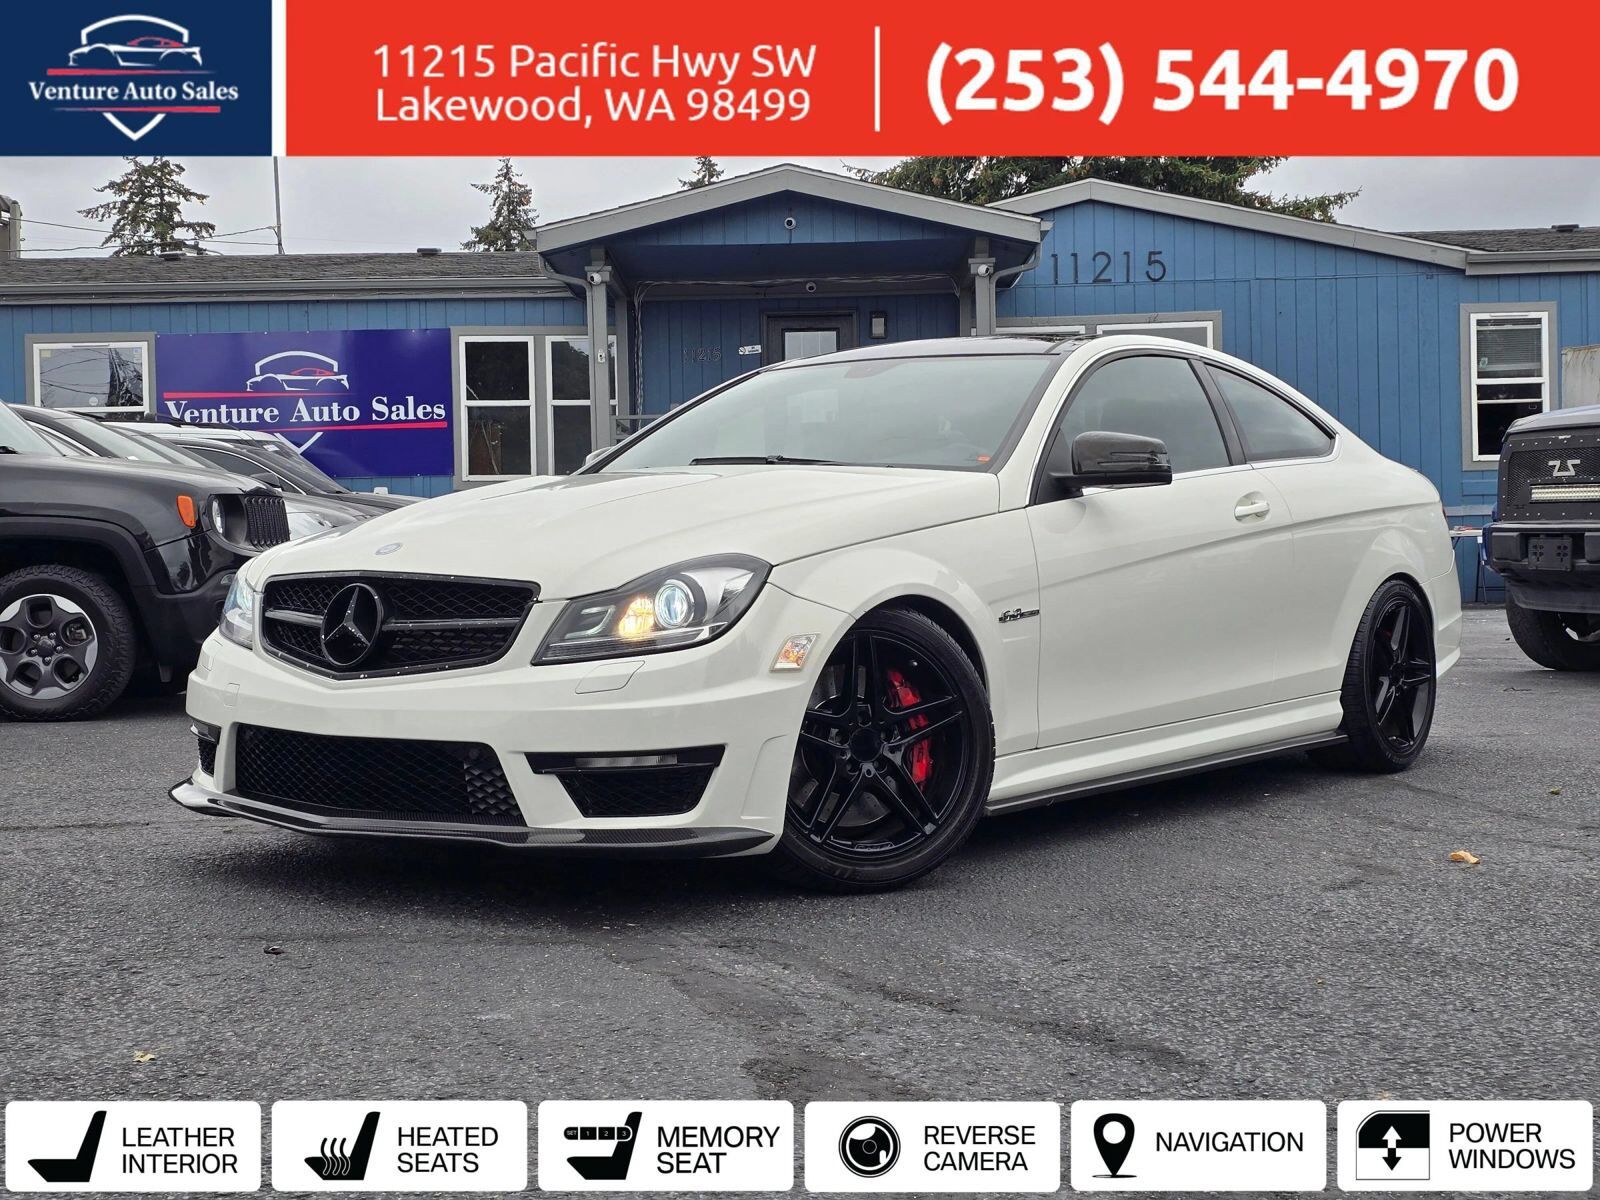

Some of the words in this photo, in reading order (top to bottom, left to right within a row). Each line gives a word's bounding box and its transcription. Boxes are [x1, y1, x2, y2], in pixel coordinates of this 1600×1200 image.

[1050, 250, 1167, 285] 11215
[164, 400, 280, 424] Venture
[290, 398, 360, 422] Auto
[371, 396, 446, 421] Sales
